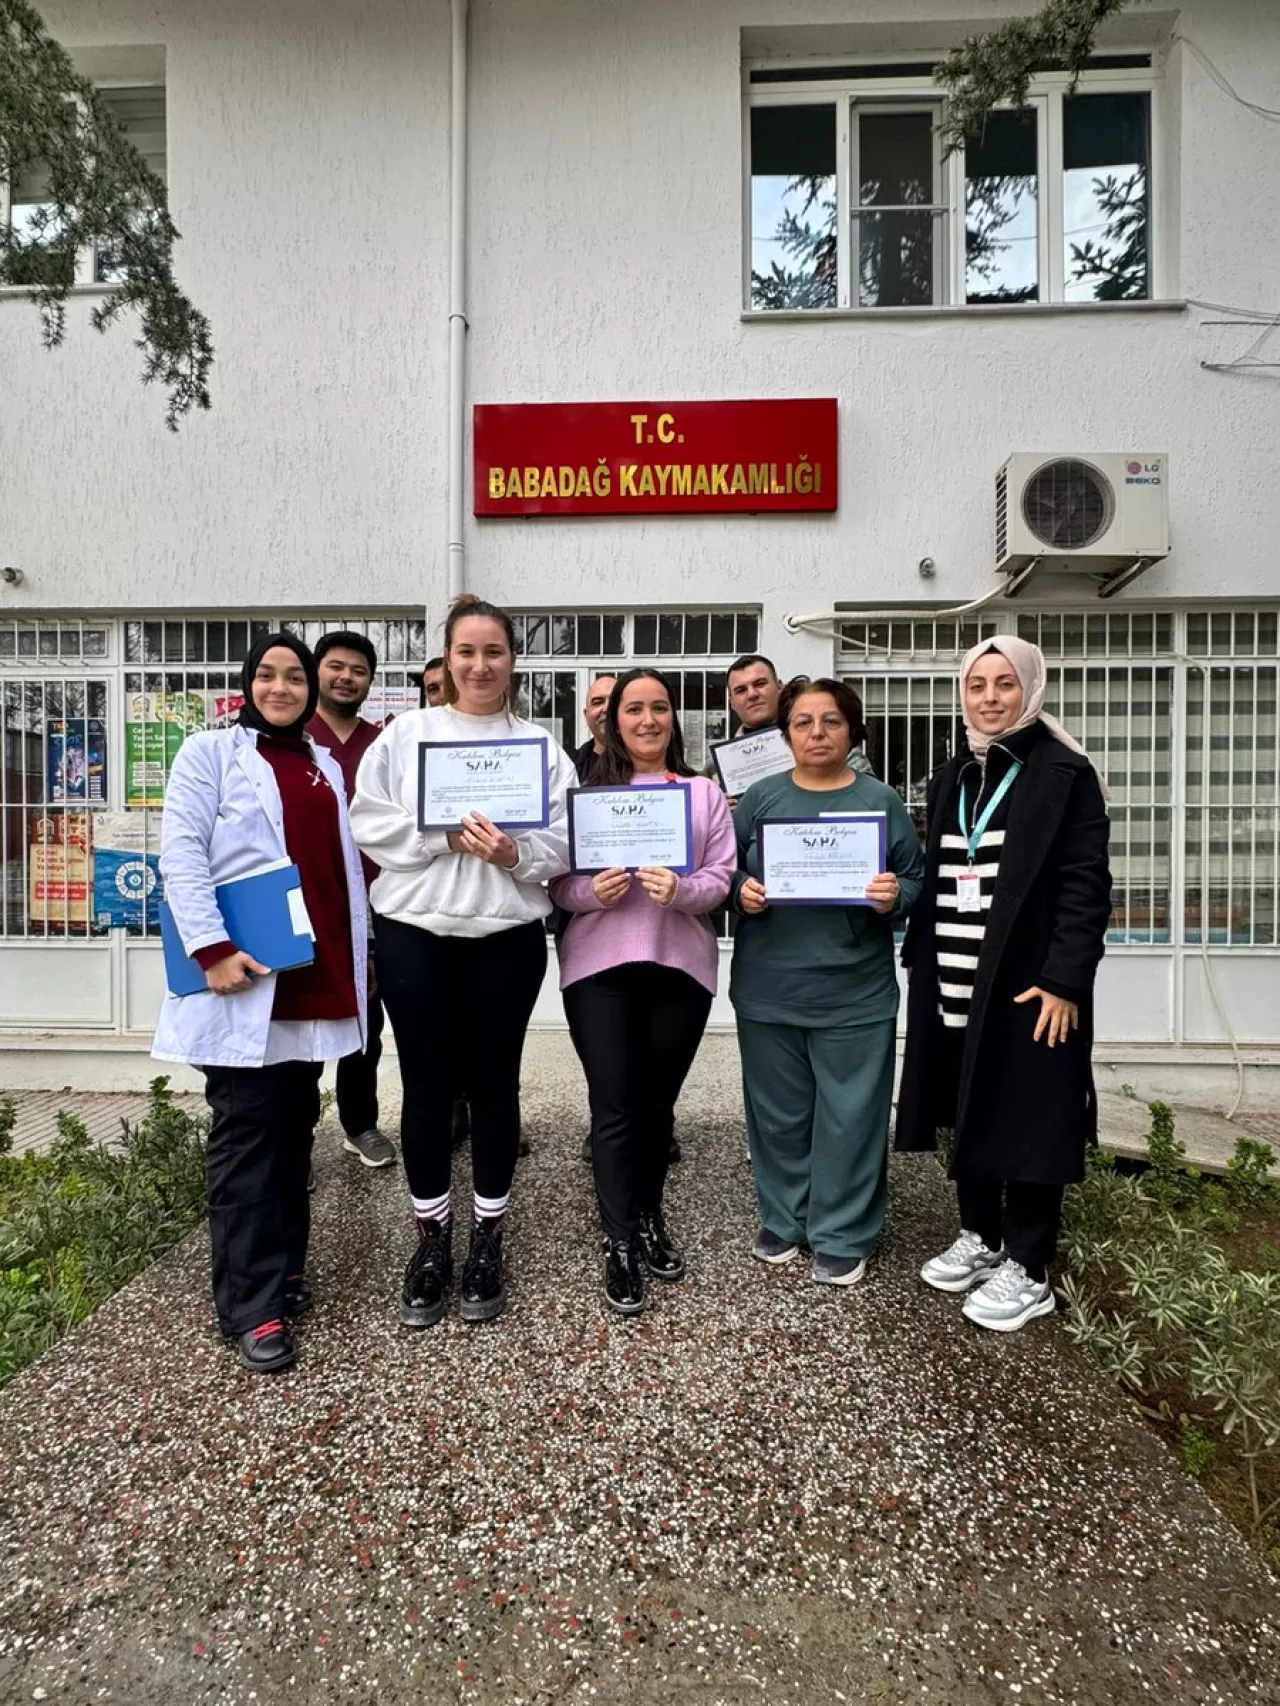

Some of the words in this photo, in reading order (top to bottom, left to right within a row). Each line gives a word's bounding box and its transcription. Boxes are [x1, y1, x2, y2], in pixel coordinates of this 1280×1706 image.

[630, 413, 685, 444] T.C.
[488, 457, 611, 499] BABADAĞ
[619, 454, 822, 497] KAYMAKAMLIĞI
[1144, 464, 1160, 473] LG
